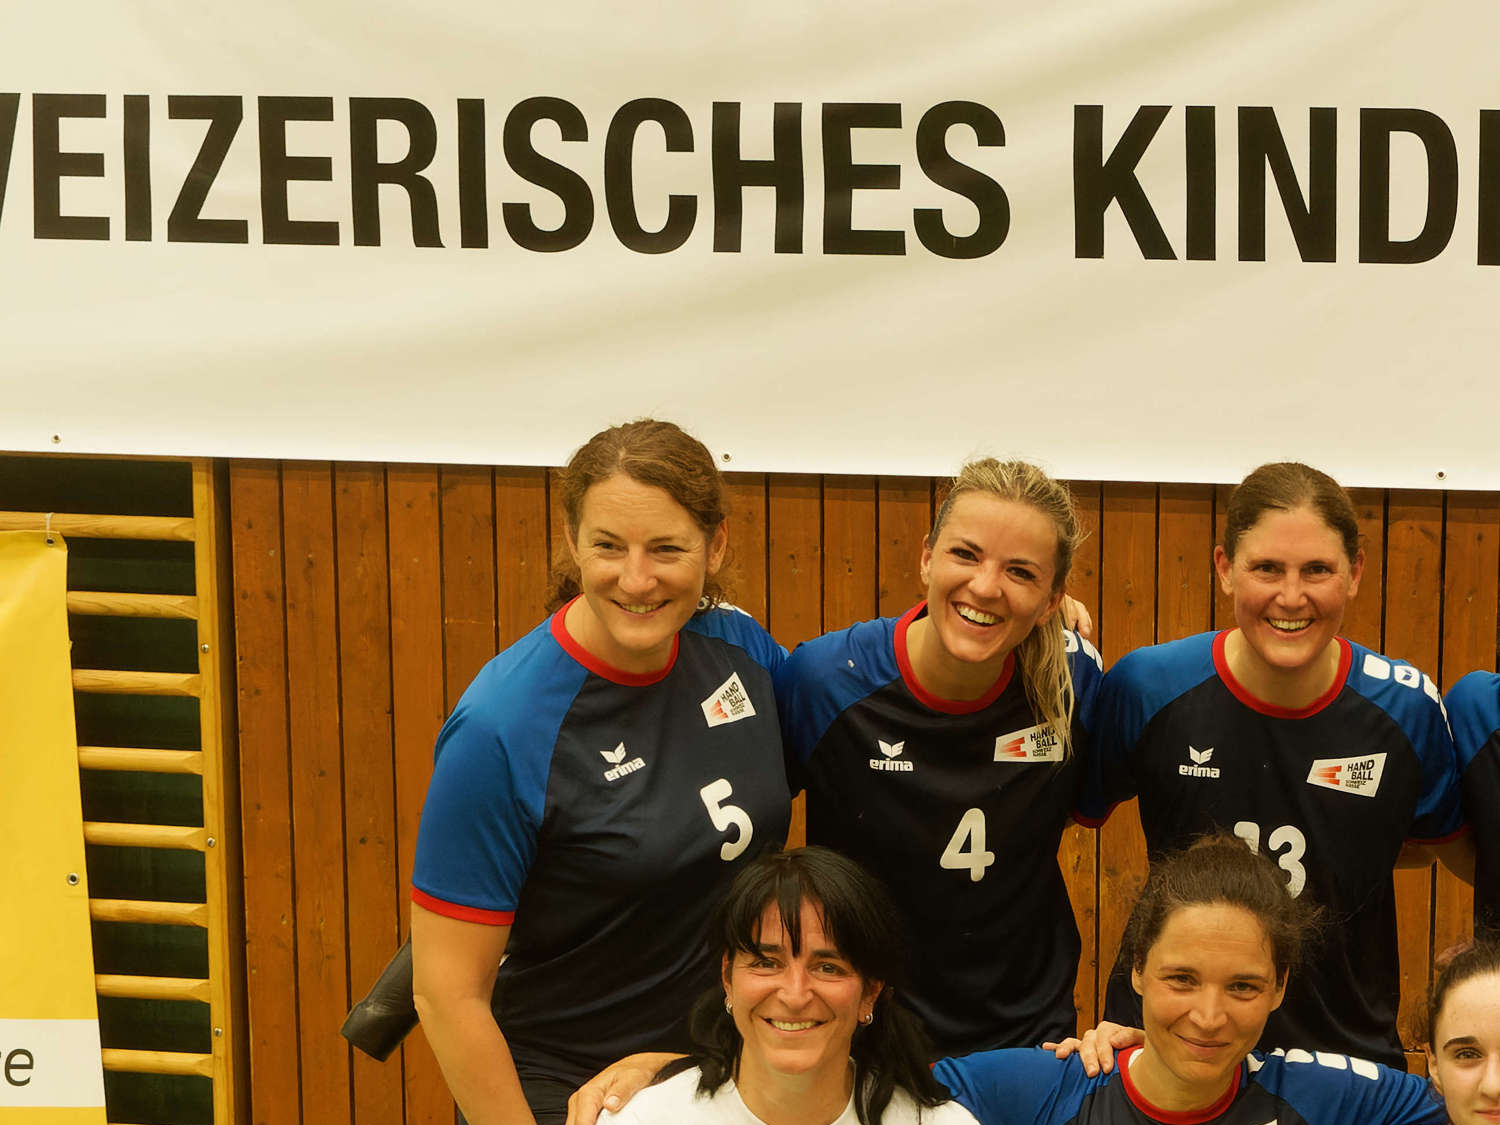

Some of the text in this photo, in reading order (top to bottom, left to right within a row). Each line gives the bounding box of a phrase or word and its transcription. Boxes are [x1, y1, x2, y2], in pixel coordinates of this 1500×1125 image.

[0, 92, 1011, 259] EIZERISCHES
[721, 681, 740, 701] HAND
[729, 691, 746, 707] BALL
[1036, 736, 1058, 749] BALL
[604, 757, 646, 782] erima
[869, 758, 914, 772] erima
[1178, 764, 1221, 779] erima
[1347, 759, 1375, 773] HAND
[1351, 770, 1374, 781] BALL
[700, 778, 754, 861] 5
[939, 807, 995, 882] 4
[0, 1048, 34, 1087] e
